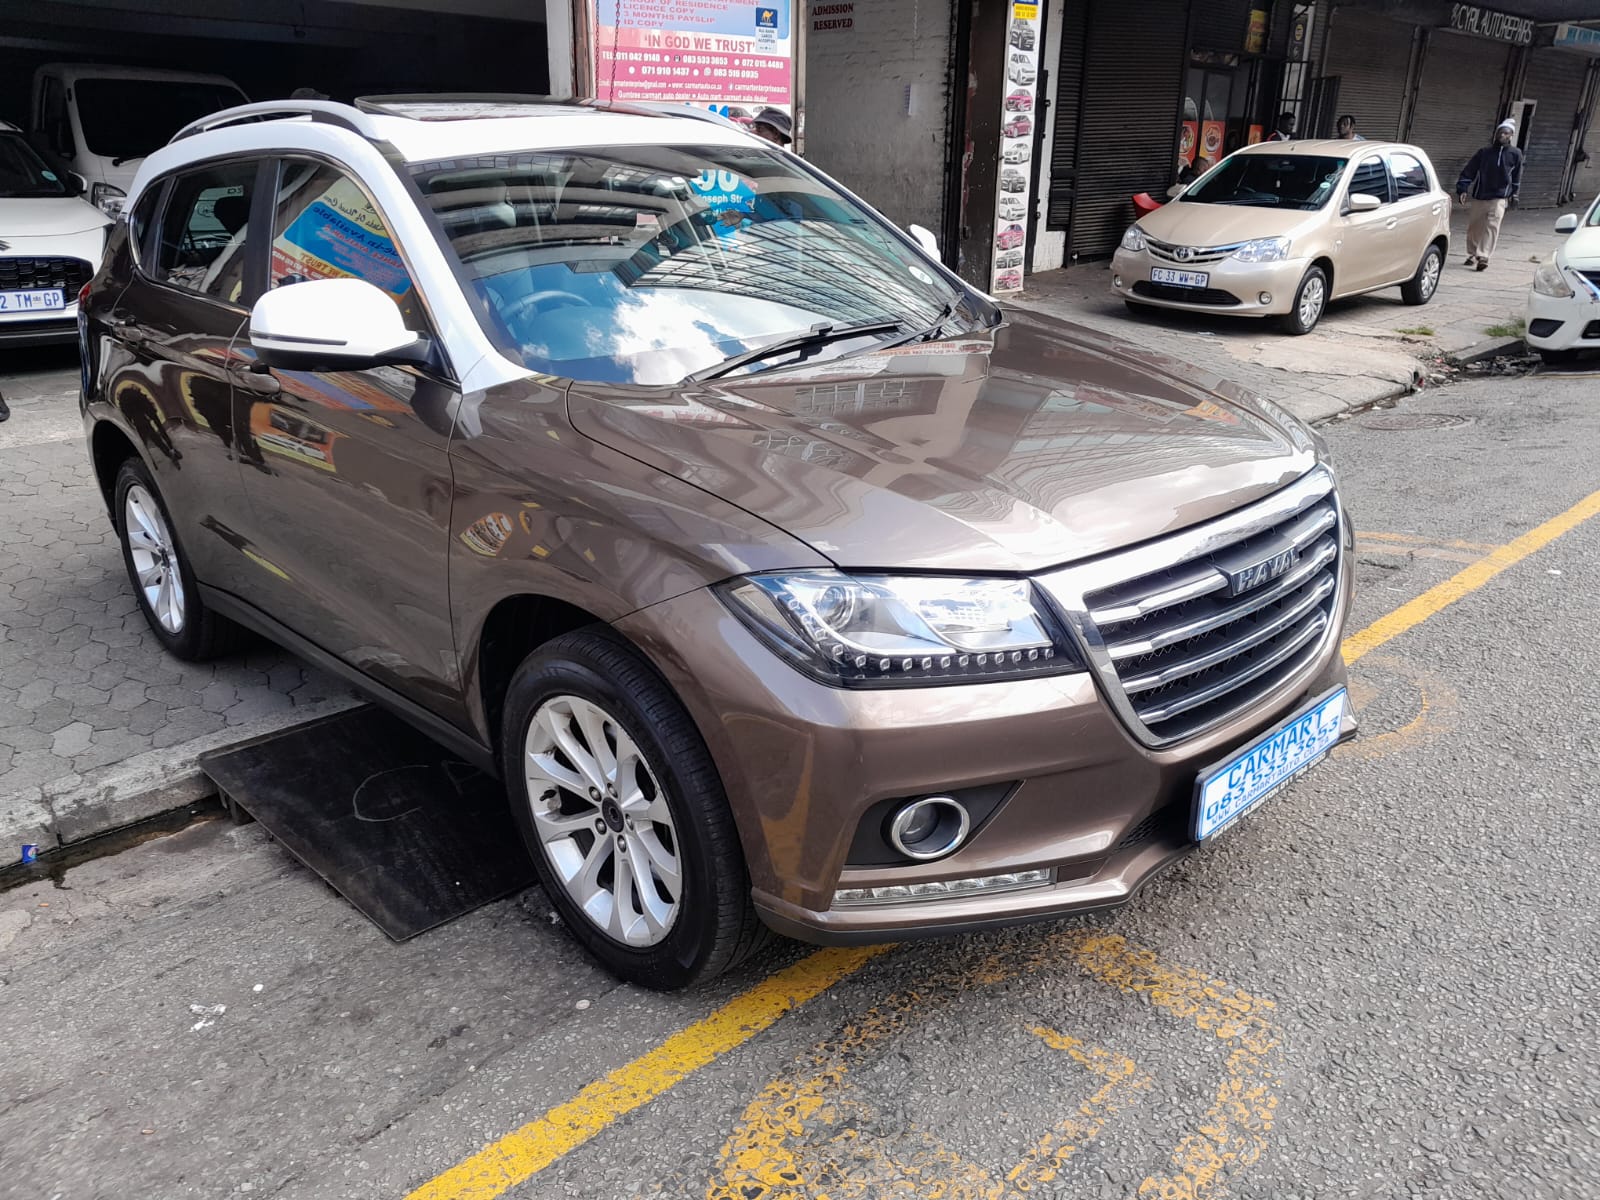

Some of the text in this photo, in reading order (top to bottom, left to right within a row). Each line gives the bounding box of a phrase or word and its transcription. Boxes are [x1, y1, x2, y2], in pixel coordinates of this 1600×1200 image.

[623, 3, 666, 12] LICENCE
[675, 0, 729, 11] RESIDENCE
[811, 3, 854, 16] ADMISSION
[632, 11, 675, 20] MONTHS
[677, 15, 716, 23] PAYSLIP
[813, 18, 853, 31] RESERVED
[665, 36, 690, 49] GOD
[693, 37, 712, 50] WE
[699, 193, 743, 205] oseph Str
[1153, 269, 1163, 280] FC
[1166, 270, 1176, 281] 33
[1194, 274, 1206, 285] GP
[15, 293, 32, 308] TM
[43, 292, 60, 306] GP
[1237, 548, 1300, 593] HAVAL
[1227, 706, 1327, 791] CARMART
[1206, 715, 1340, 821] 083 533 3653
